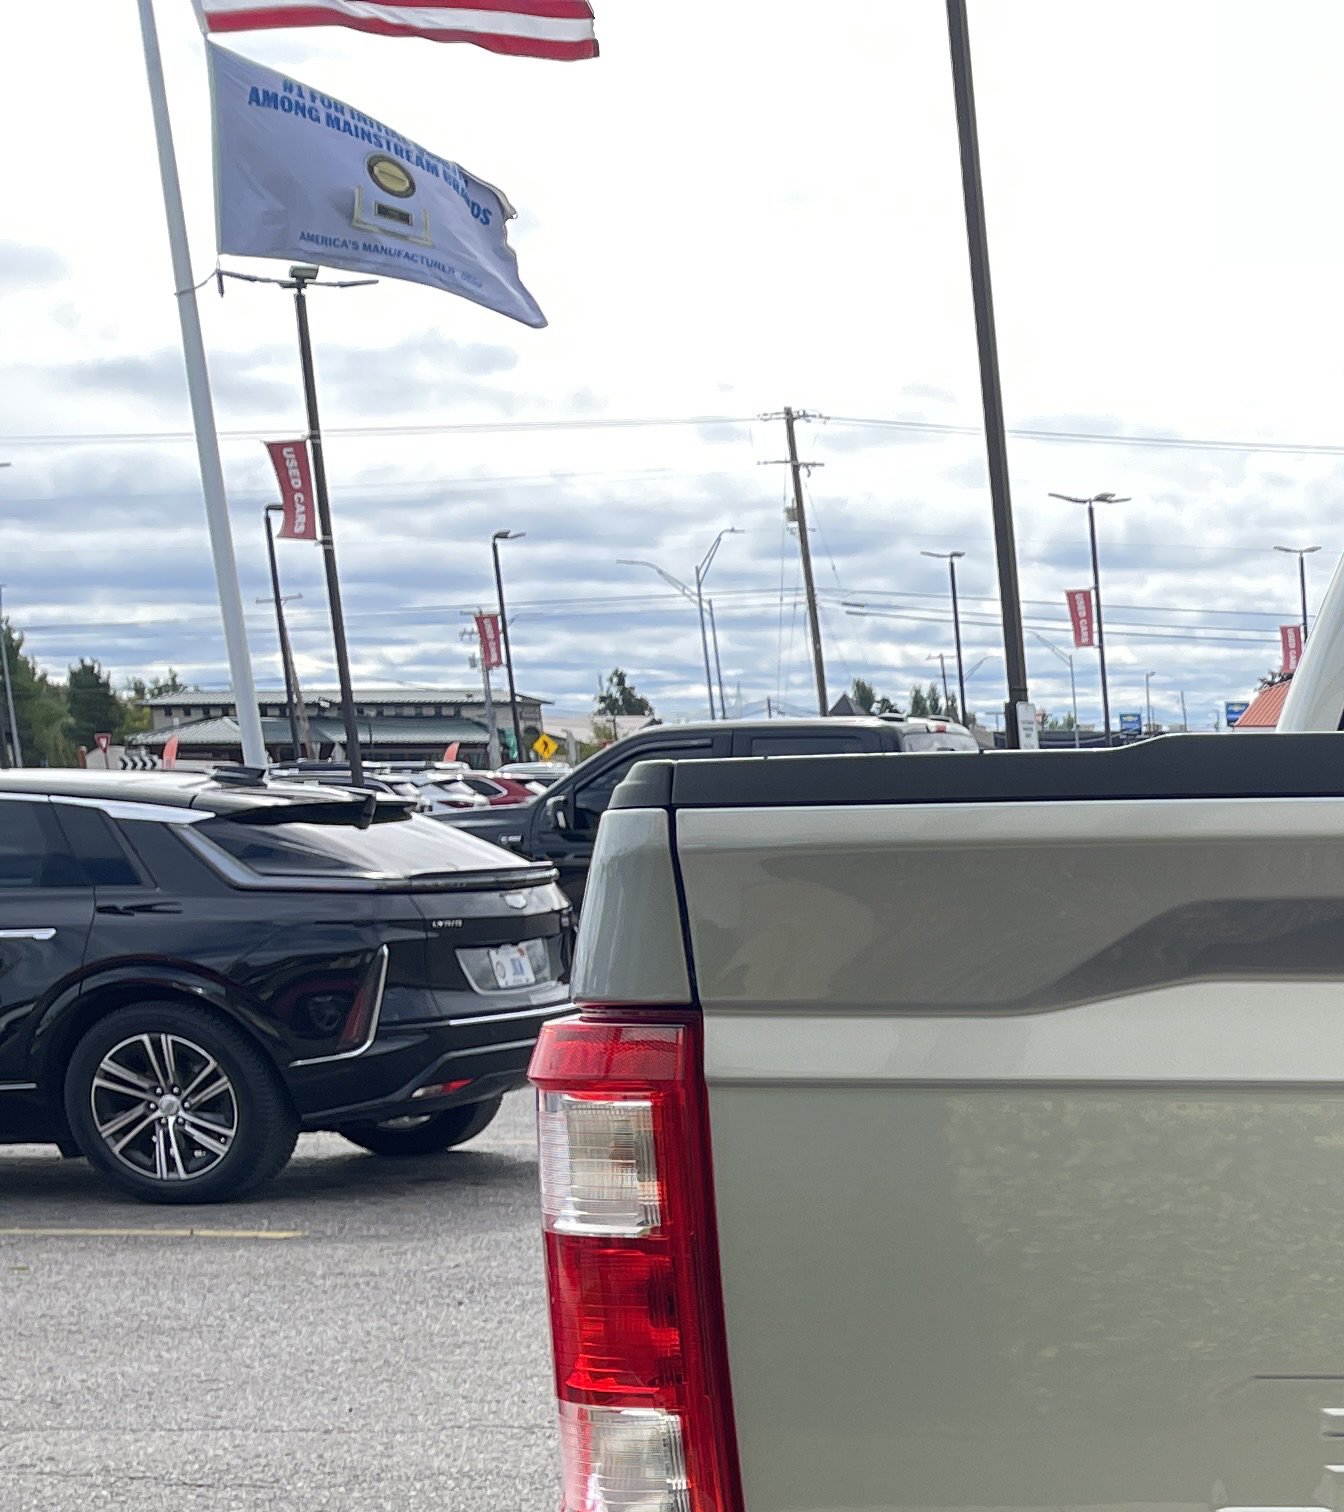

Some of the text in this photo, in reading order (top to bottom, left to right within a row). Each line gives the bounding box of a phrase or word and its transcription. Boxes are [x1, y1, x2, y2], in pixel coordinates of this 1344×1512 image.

[248, 86, 321, 124] AMONG
[300, 231, 359, 251] AMERICA'S
[282, 447, 306, 535] USED CARS
